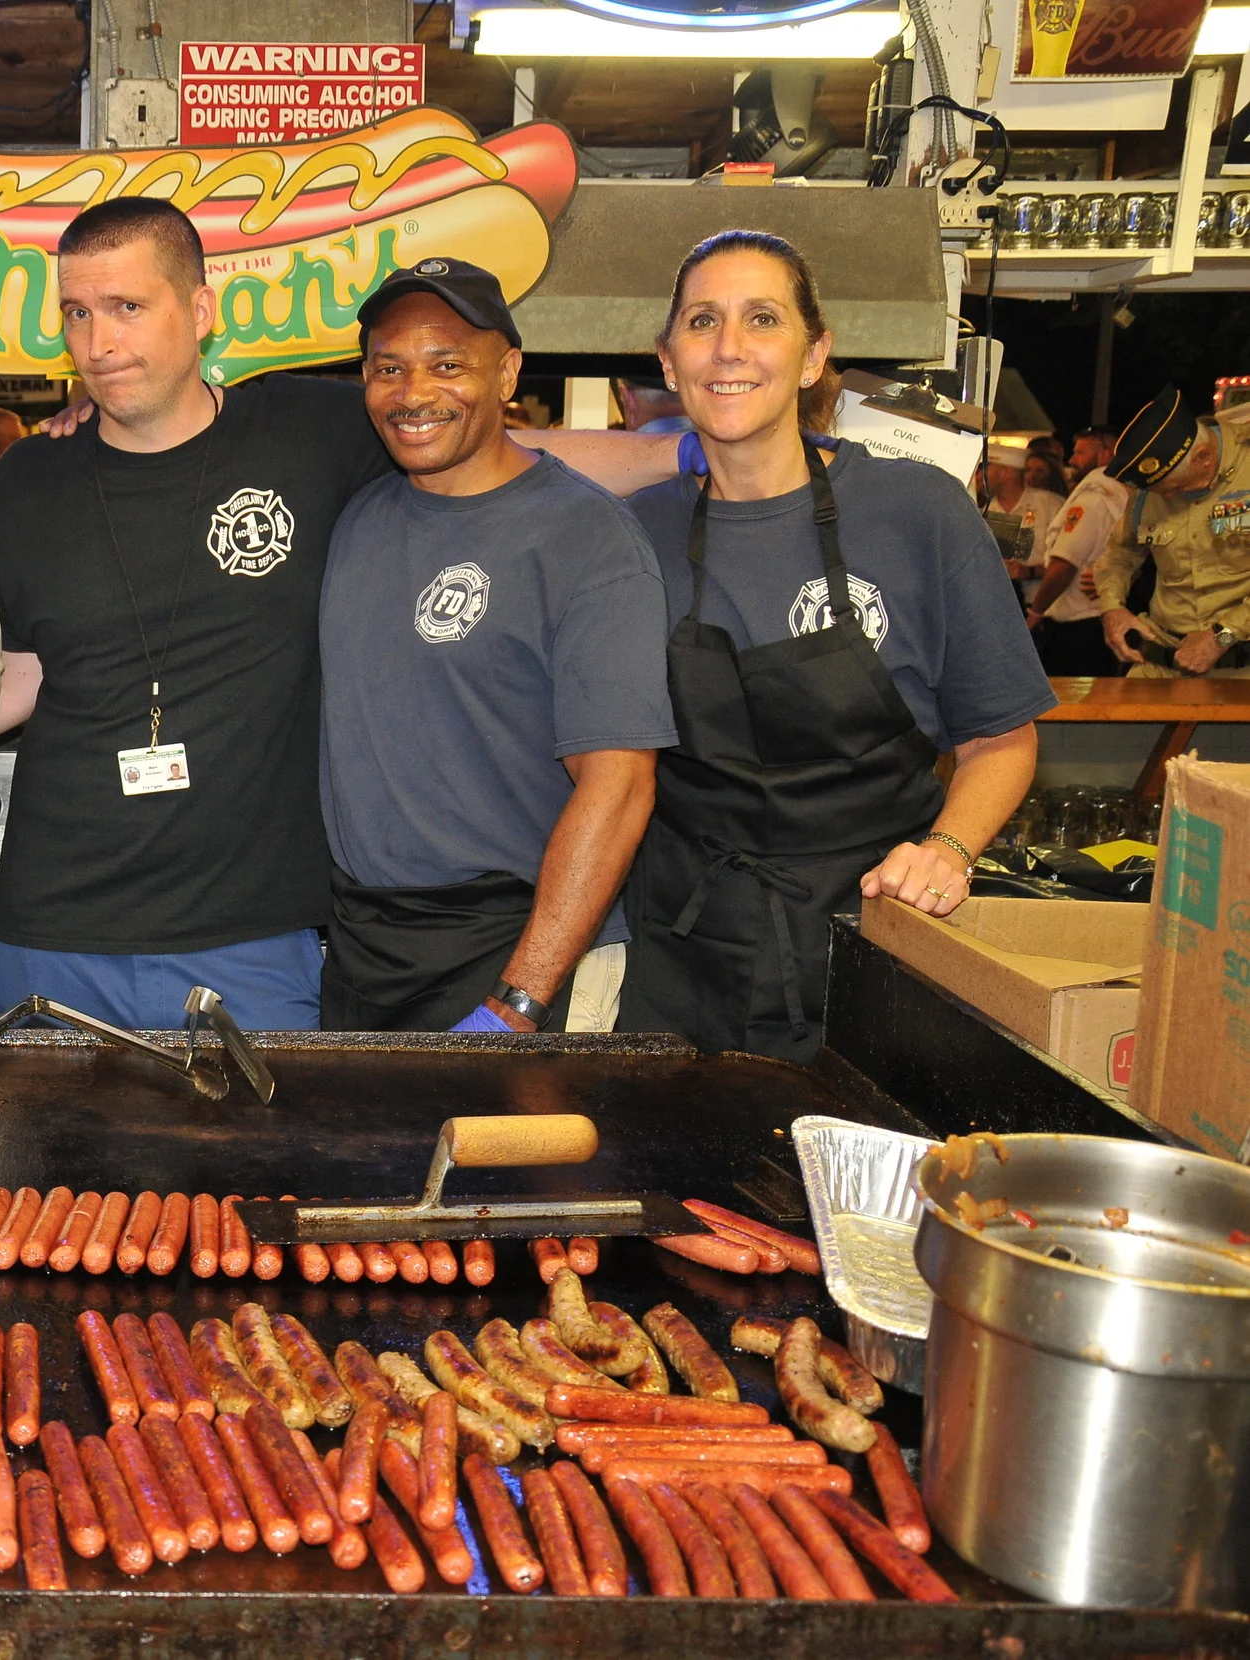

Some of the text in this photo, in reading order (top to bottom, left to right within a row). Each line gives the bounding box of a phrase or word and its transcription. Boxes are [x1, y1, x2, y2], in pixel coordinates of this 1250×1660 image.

[1070, 4, 1200, 66] Bud
[188, 46, 415, 73] WARNING:
[184, 84, 417, 106] CONSUMING ALCOHOL
[191, 107, 398, 129] DURING PREGNAN
[893, 428, 921, 443] CVAC
[862, 438, 902, 457] CHARGE
[229, 494, 265, 515] GREENLAWN
[240, 512, 265, 550] 1
[258, 523, 271, 533] CO.
[241, 552, 275, 570] FIRE DEPT.
[433, 588, 466, 616] FD
[816, 585, 867, 600] GRAWN
